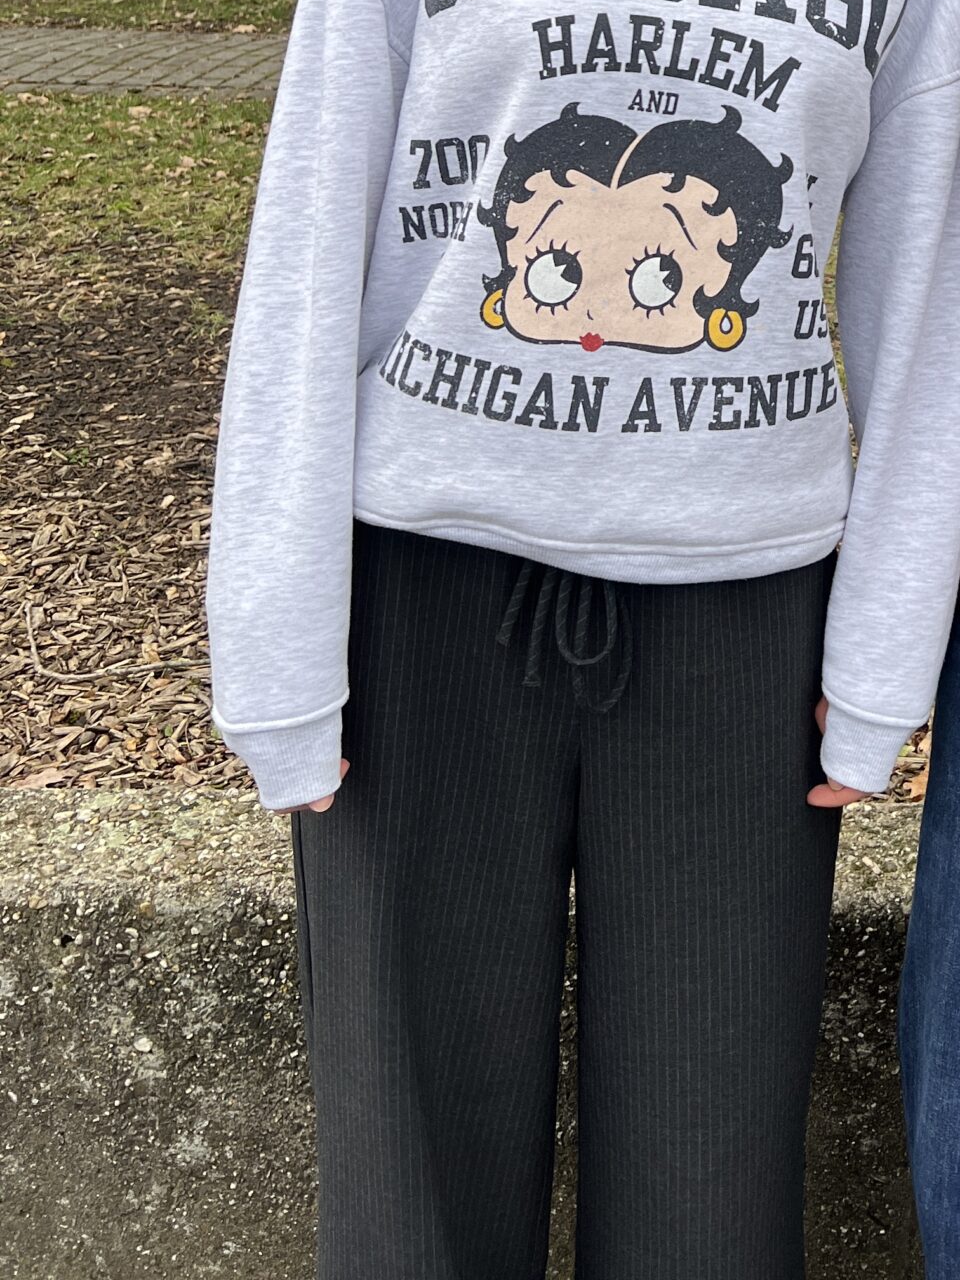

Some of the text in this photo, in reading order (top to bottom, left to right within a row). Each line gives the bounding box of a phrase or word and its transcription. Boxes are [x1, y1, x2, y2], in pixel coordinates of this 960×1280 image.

[532, 13, 802, 112] HARLEM
[628, 89, 679, 115] AND
[379, 328, 837, 432] ICHIGAN AVENUE
